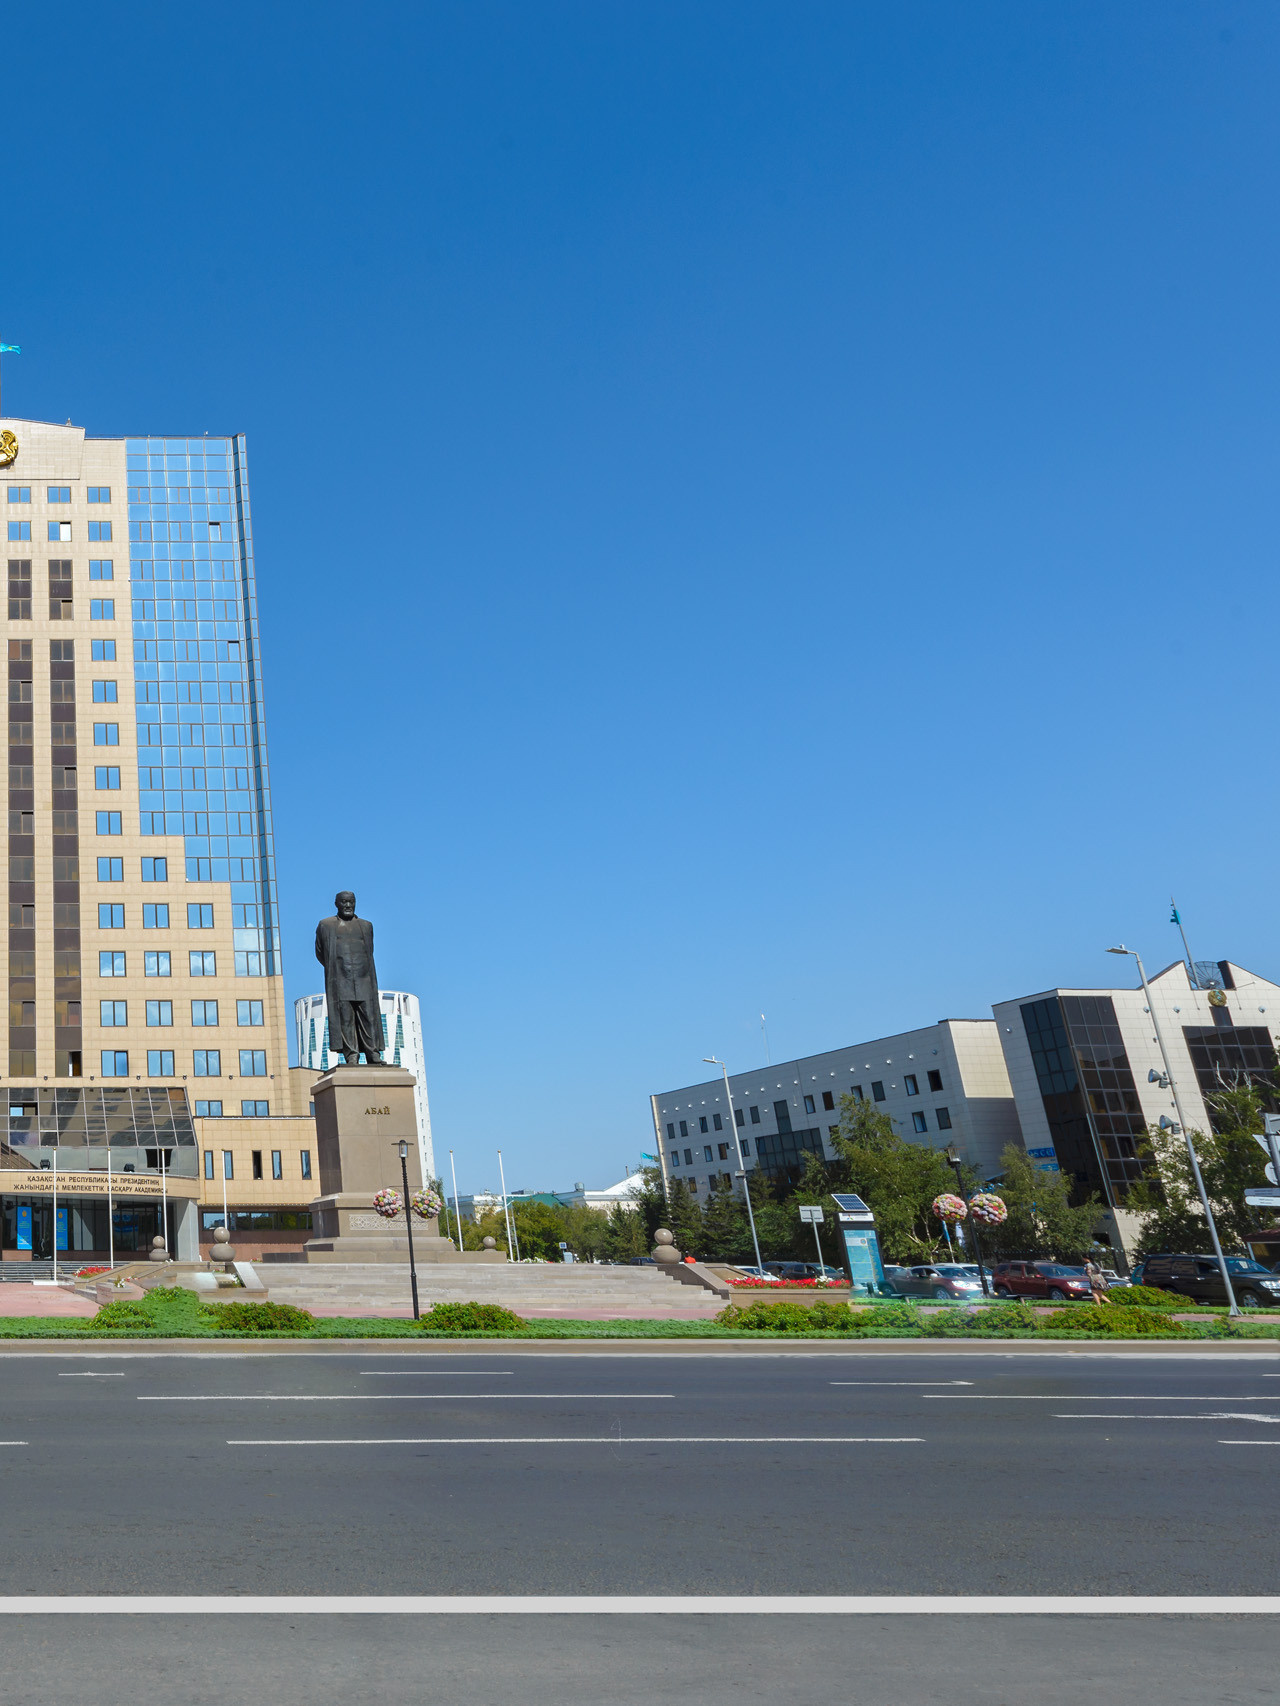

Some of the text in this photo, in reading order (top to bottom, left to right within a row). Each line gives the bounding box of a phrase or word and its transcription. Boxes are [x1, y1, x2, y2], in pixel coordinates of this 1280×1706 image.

[364, 1106, 391, 1115] АБАЙ
[27, 1175, 66, 1183] ҚАЗАҚСАН
[61, 1184, 105, 1192] МЕМЛЕКЕТТІК
